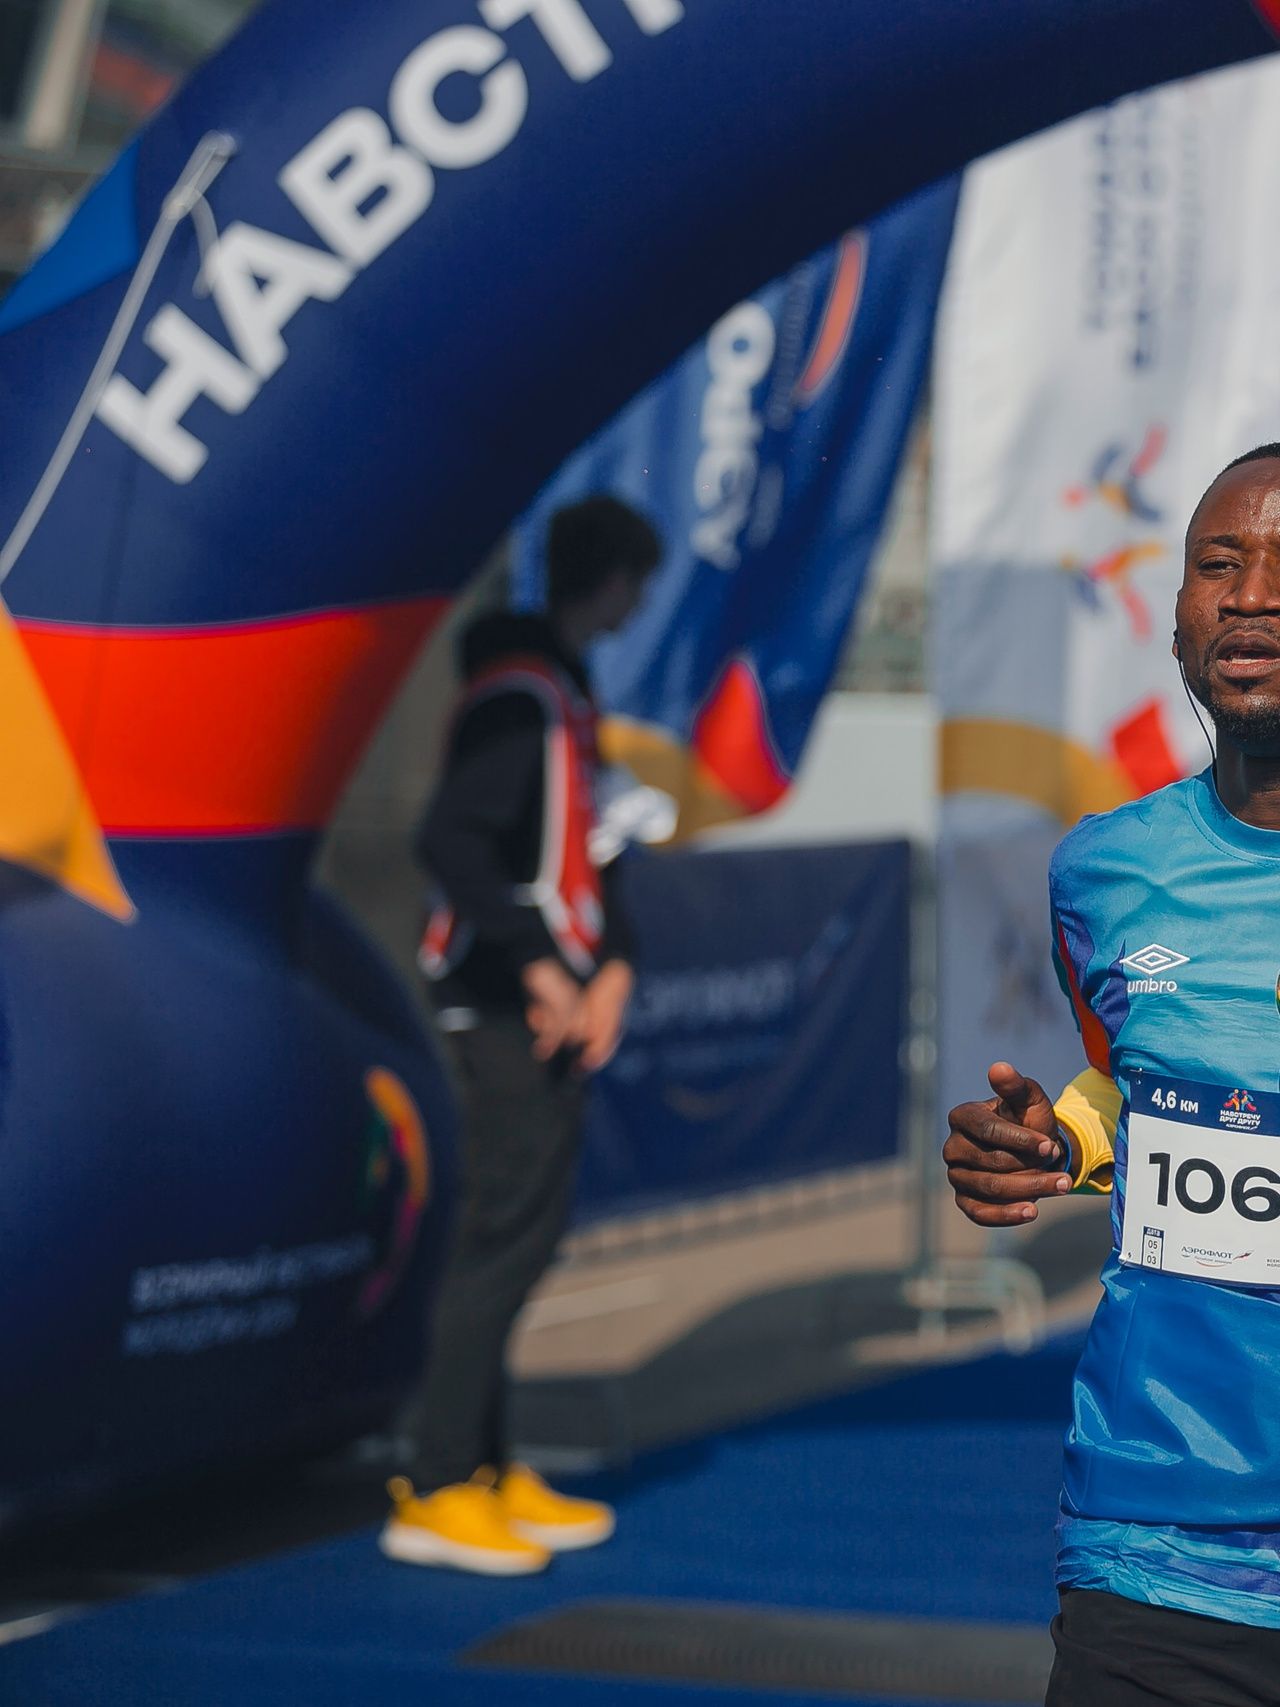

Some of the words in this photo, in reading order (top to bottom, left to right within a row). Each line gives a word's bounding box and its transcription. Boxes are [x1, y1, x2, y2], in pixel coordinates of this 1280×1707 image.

[95, 0, 686, 486] НАВСТ
[1127, 977, 1178, 993] umbro
[1151, 1088, 1176, 1111] 4,6
[1219, 1115, 1237, 1123] ДРУГ
[1237, 1117, 1260, 1126] ДРУГУ
[1148, 1240, 1158, 1250] 05
[1181, 1246, 1233, 1259] АЭРОФЛОТ
[1147, 1255, 1157, 1265] 03
